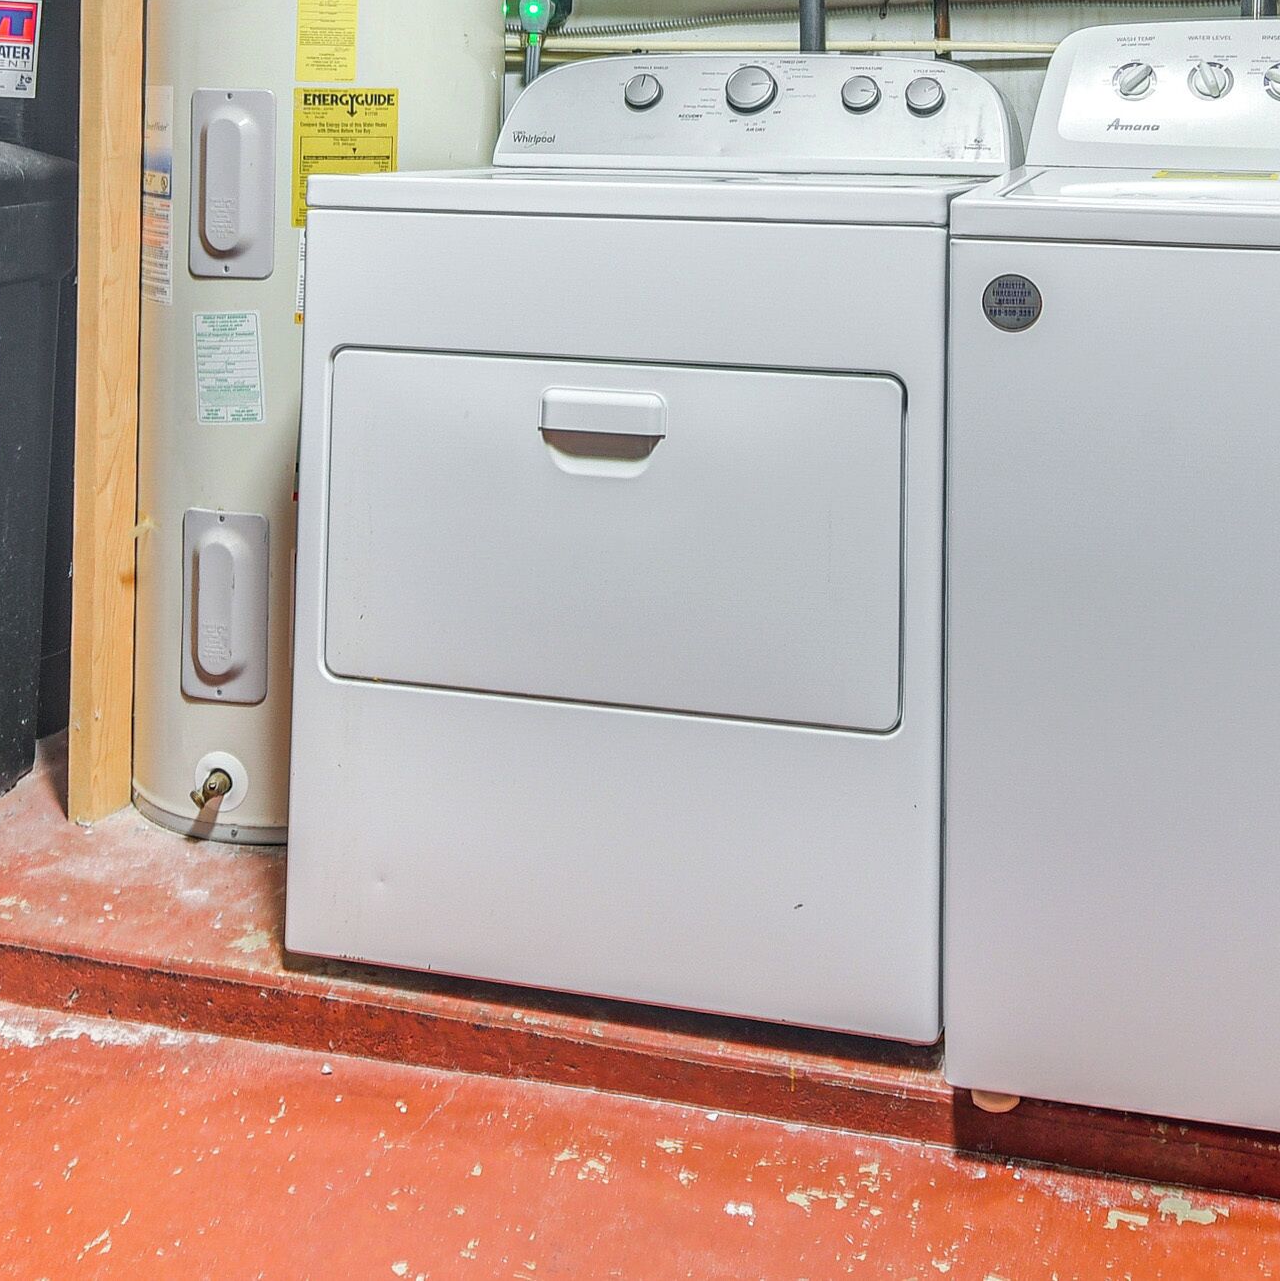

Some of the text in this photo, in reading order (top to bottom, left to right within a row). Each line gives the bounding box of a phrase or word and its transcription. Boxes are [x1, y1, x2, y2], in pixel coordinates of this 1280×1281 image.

[303, 93, 395, 110] ENERGYGUIDE
[1106, 118, 1161, 131] Amana
[512, 134, 556, 145] Whirlpool
